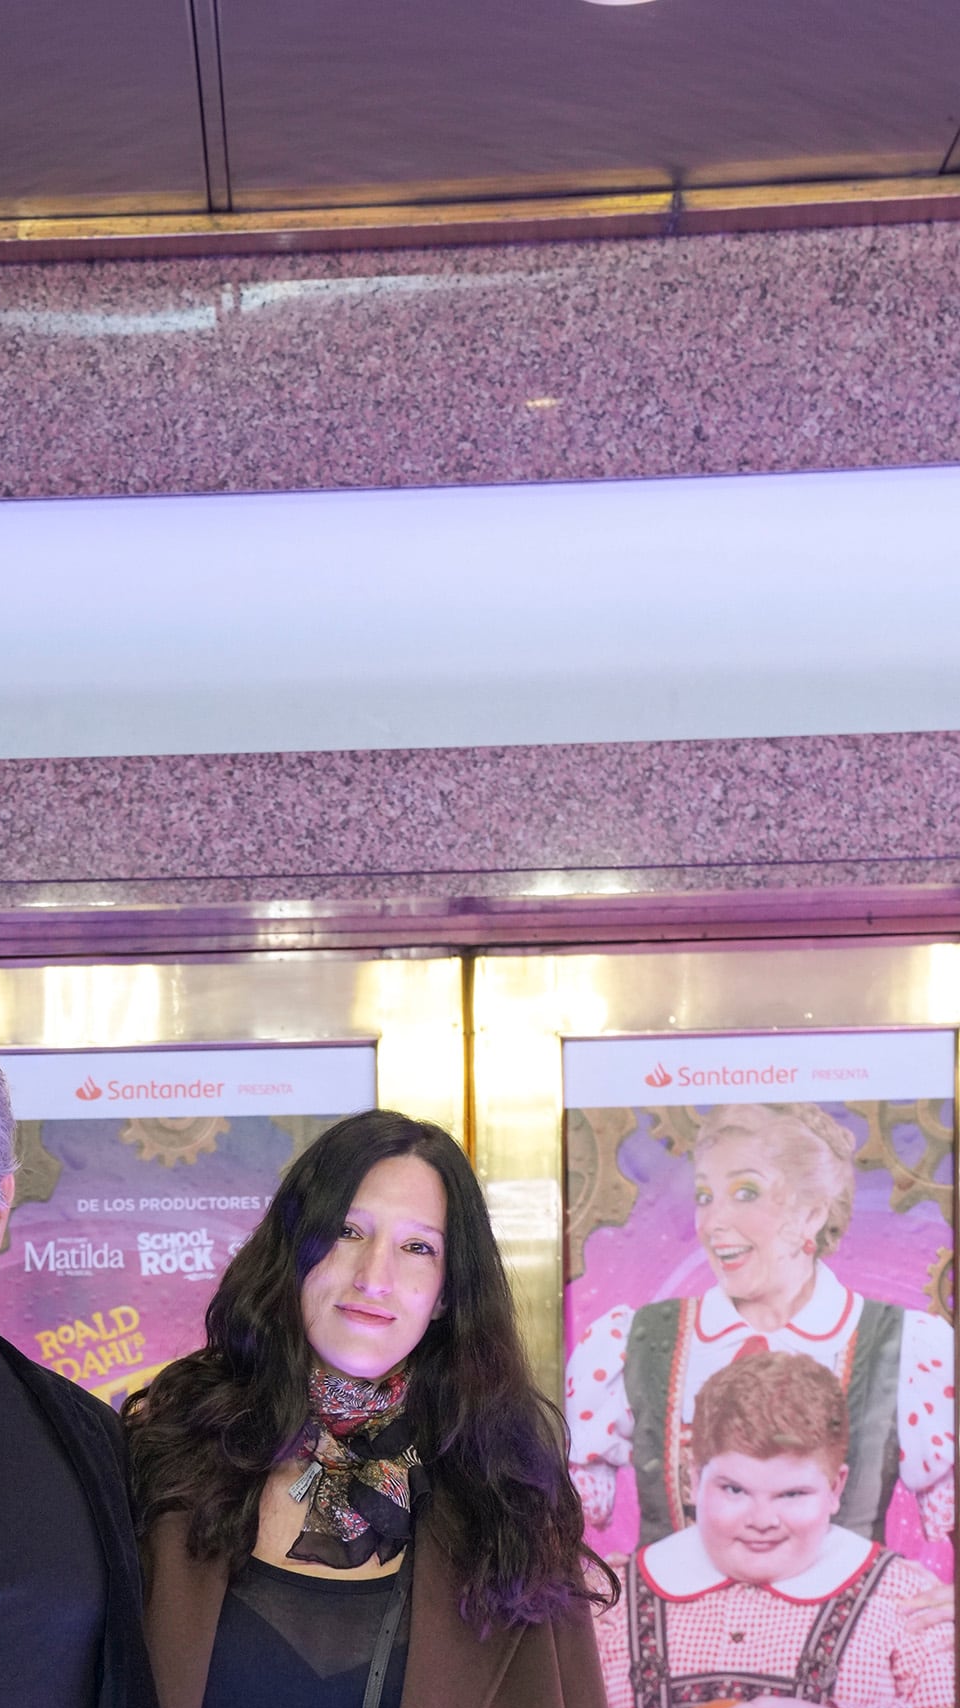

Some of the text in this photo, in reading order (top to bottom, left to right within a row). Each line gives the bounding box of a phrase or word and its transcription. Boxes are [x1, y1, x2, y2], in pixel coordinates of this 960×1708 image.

[678, 1065, 869, 1087] Santander PRESENTA
[108, 1079, 293, 1101] Santander PRESENTA
[78, 1199, 100, 1213] DE
[104, 1198, 135, 1212] LOS
[140, 1196, 261, 1211] PRODUCTORES
[137, 1228, 215, 1252] SCHOOL
[24, 1241, 125, 1272] Matilda
[140, 1246, 215, 1276] ROCK
[34, 1305, 140, 1361] ROALD
